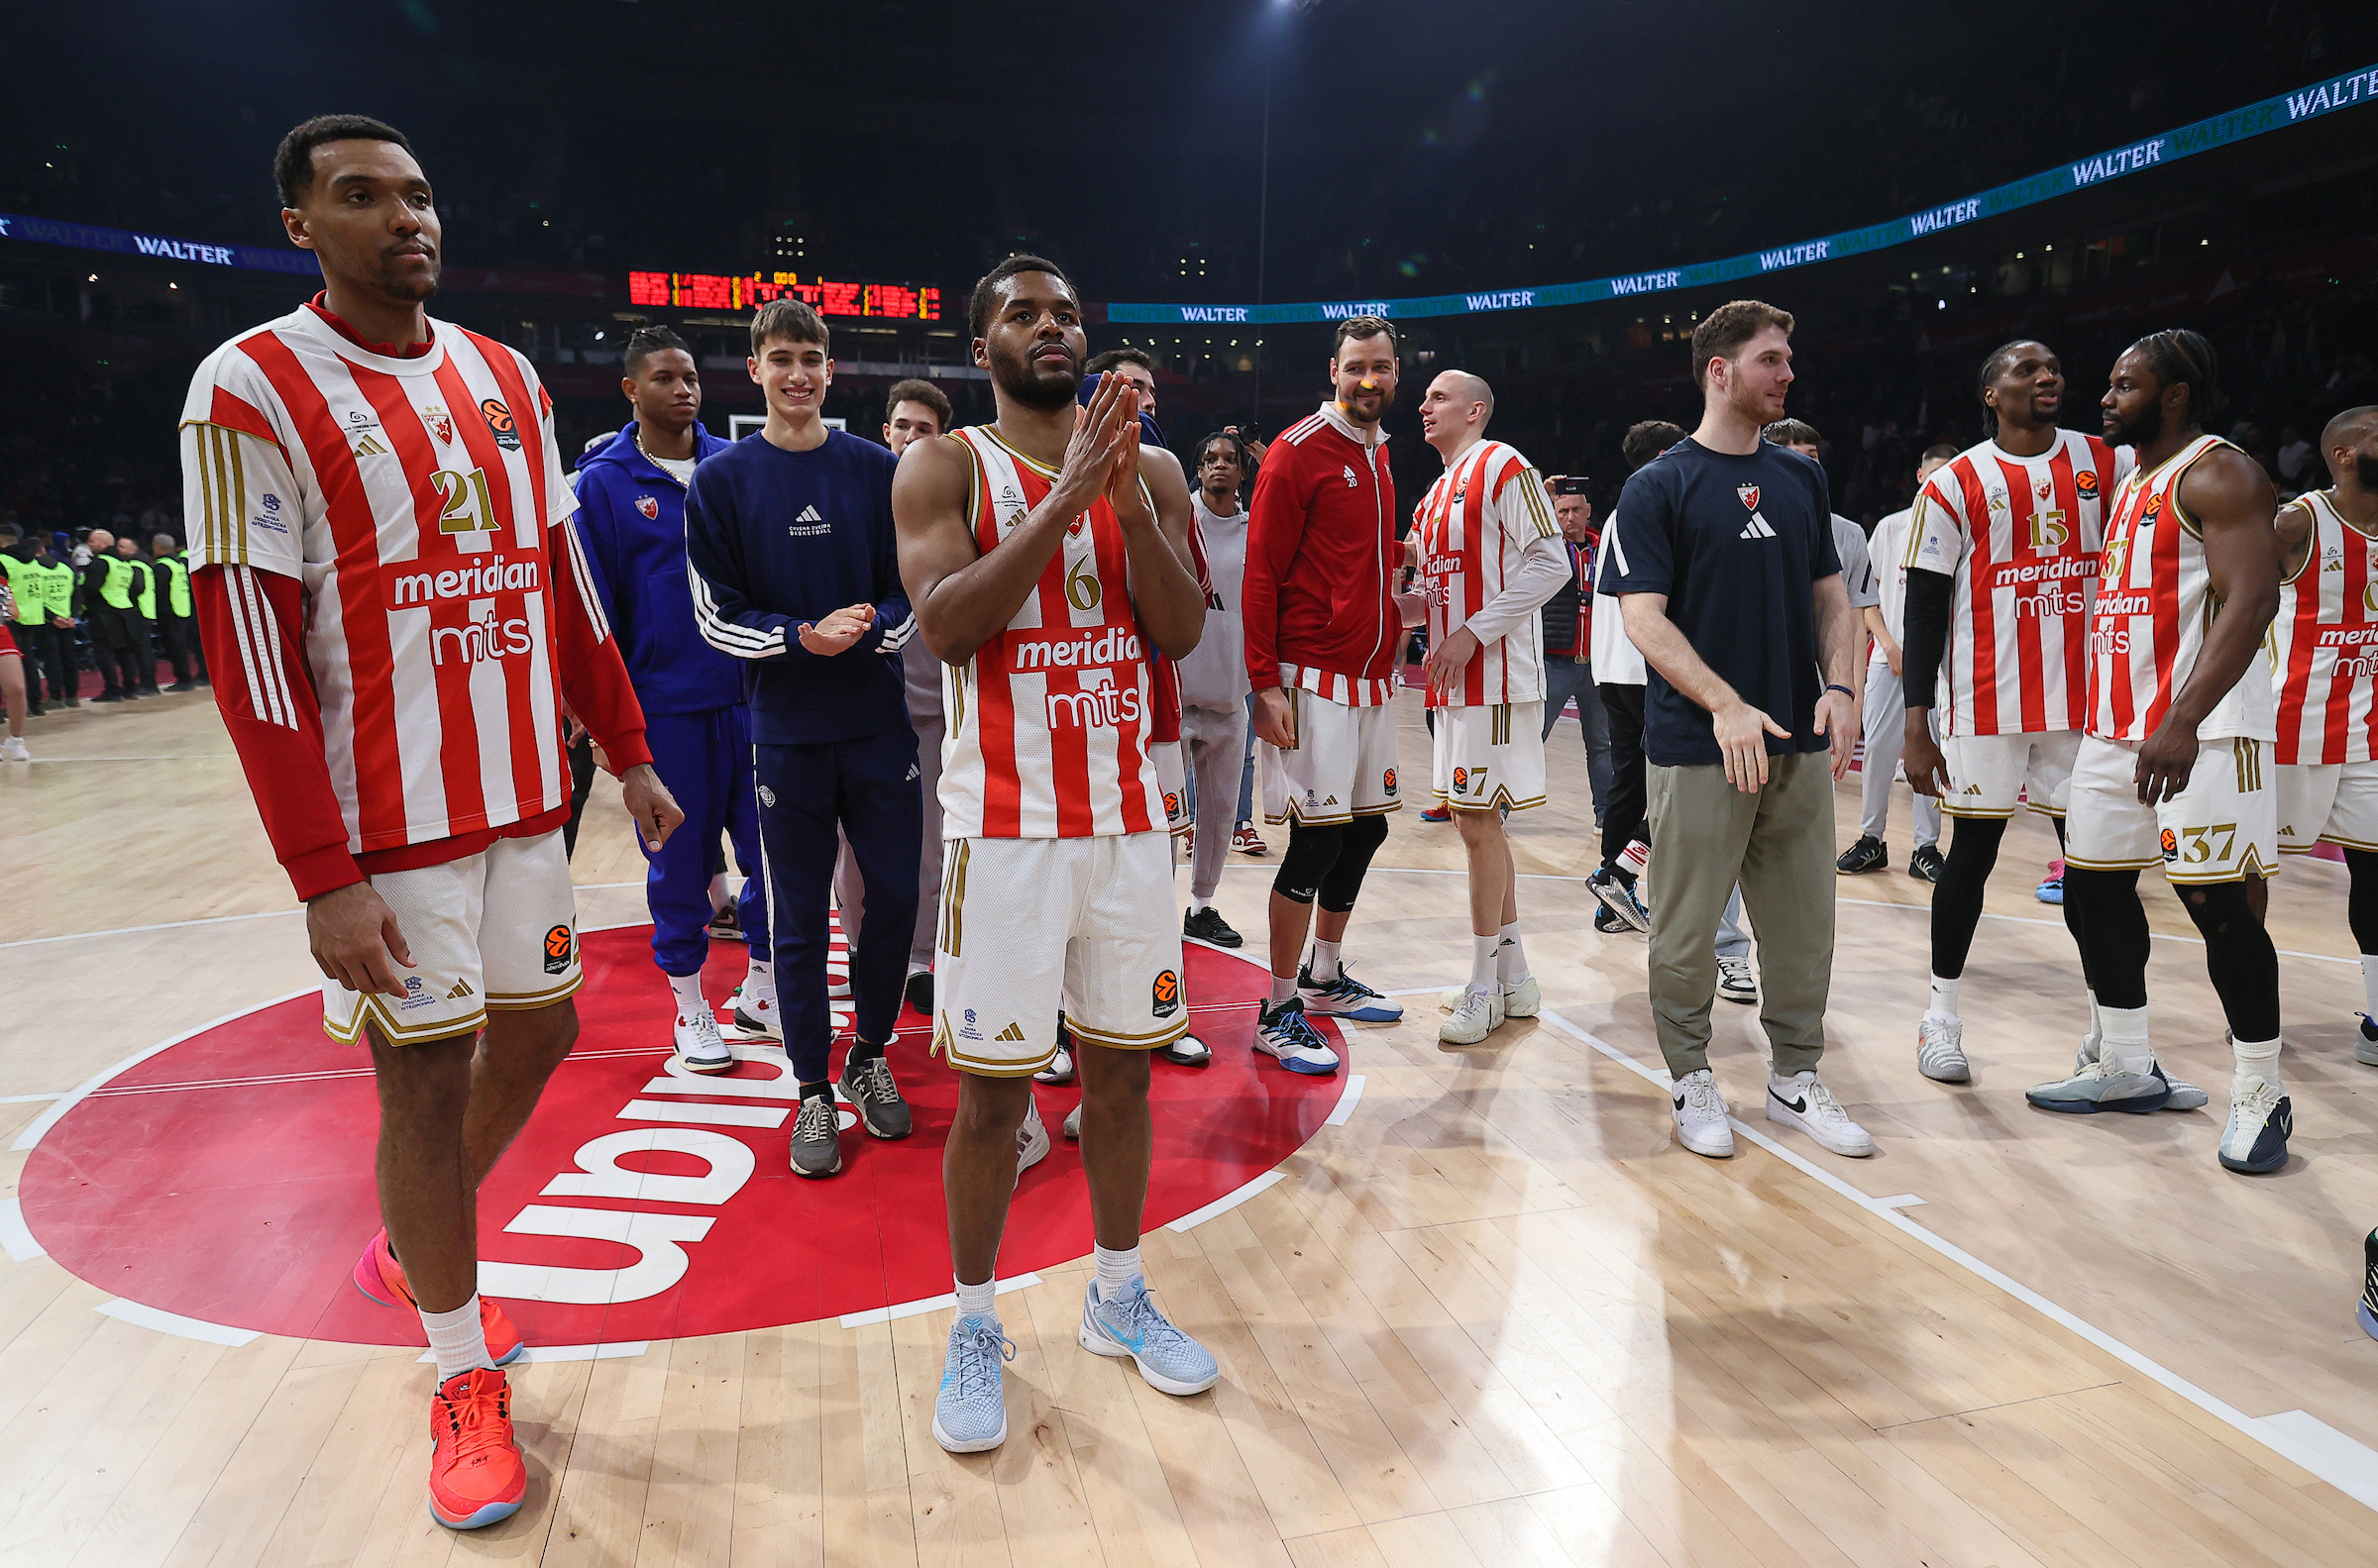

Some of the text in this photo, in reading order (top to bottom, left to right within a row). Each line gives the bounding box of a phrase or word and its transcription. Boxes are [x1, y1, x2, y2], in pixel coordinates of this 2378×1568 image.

[1180, 306, 1247, 322] WALTER
[1322, 302, 1389, 320] WALTER
[1466, 290, 1533, 310] WALTER
[1610, 270, 1680, 295] WALTER
[1760, 241, 1830, 271] WALTER
[1910, 198, 1980, 236] WALTER
[2073, 139, 2164, 186] WALTER
[2286, 68, 2378, 120] WALTE
[133, 235, 234, 265] WALTER
[429, 467, 501, 535] 21
[1347, 476, 1357, 487] 20
[2026, 509, 2070, 550] 15
[1427, 554, 1461, 575] idian
[1996, 556, 2097, 586] meridian
[2100, 537, 2130, 579] 37
[394, 554, 538, 605] meridian
[1064, 552, 1103, 611] 6
[2015, 586, 2086, 619] mts
[2093, 591, 2150, 616] eridian
[432, 610, 532, 667] mts
[1016, 626, 1142, 669] meridia
[2331, 650, 2378, 678] mt
[1046, 679, 1140, 730] mts
[1470, 766, 1489, 796] 7
[2182, 823, 2236, 863] 37
